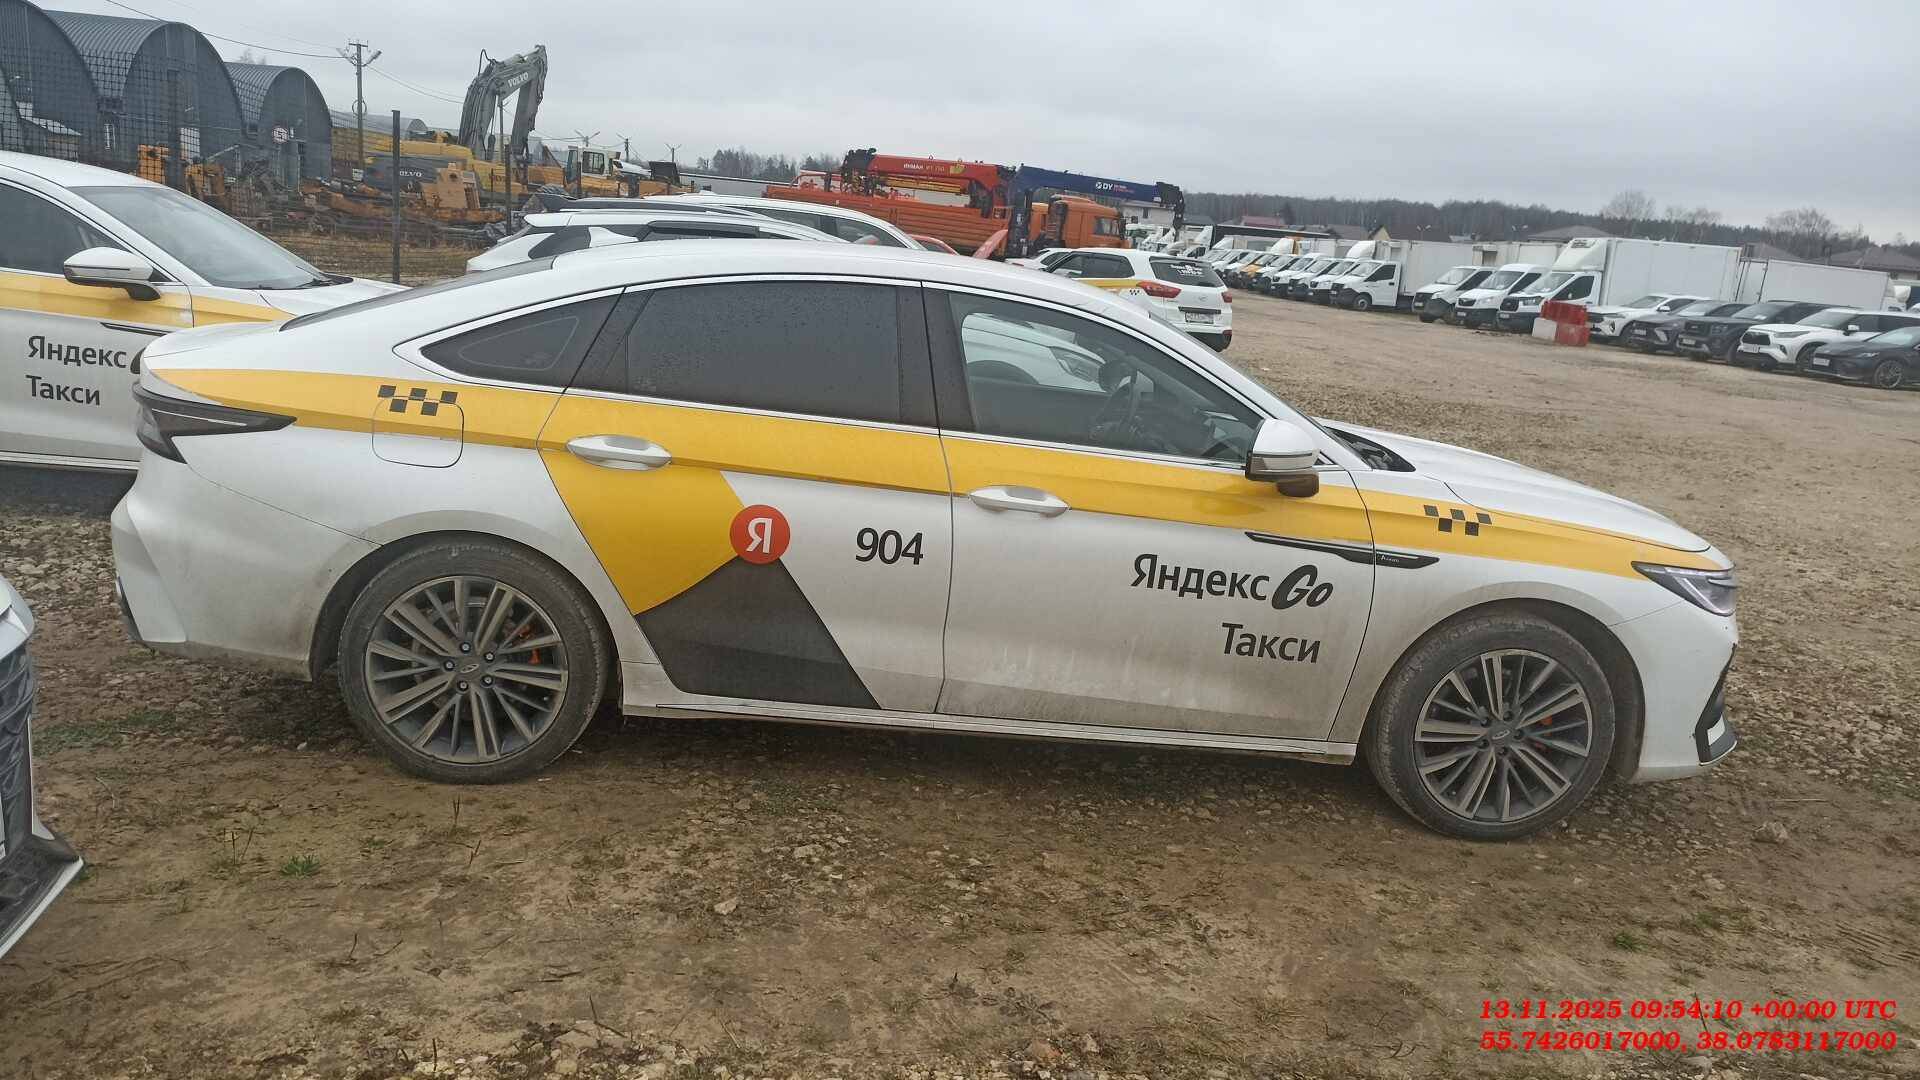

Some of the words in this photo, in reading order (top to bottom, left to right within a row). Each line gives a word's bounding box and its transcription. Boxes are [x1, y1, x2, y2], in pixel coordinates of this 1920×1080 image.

[507, 72, 529, 88] VOLVO
[399, 170, 422, 178] OLVO
[28, 335, 127, 368] Яндекс
[25, 374, 101, 406] Такси
[746, 517, 773, 554] Я
[855, 527, 924, 565] 904
[1131, 553, 1271, 600] Яндекс
[1271, 564, 1334, 610] Go
[1222, 622, 1321, 664] Такси
